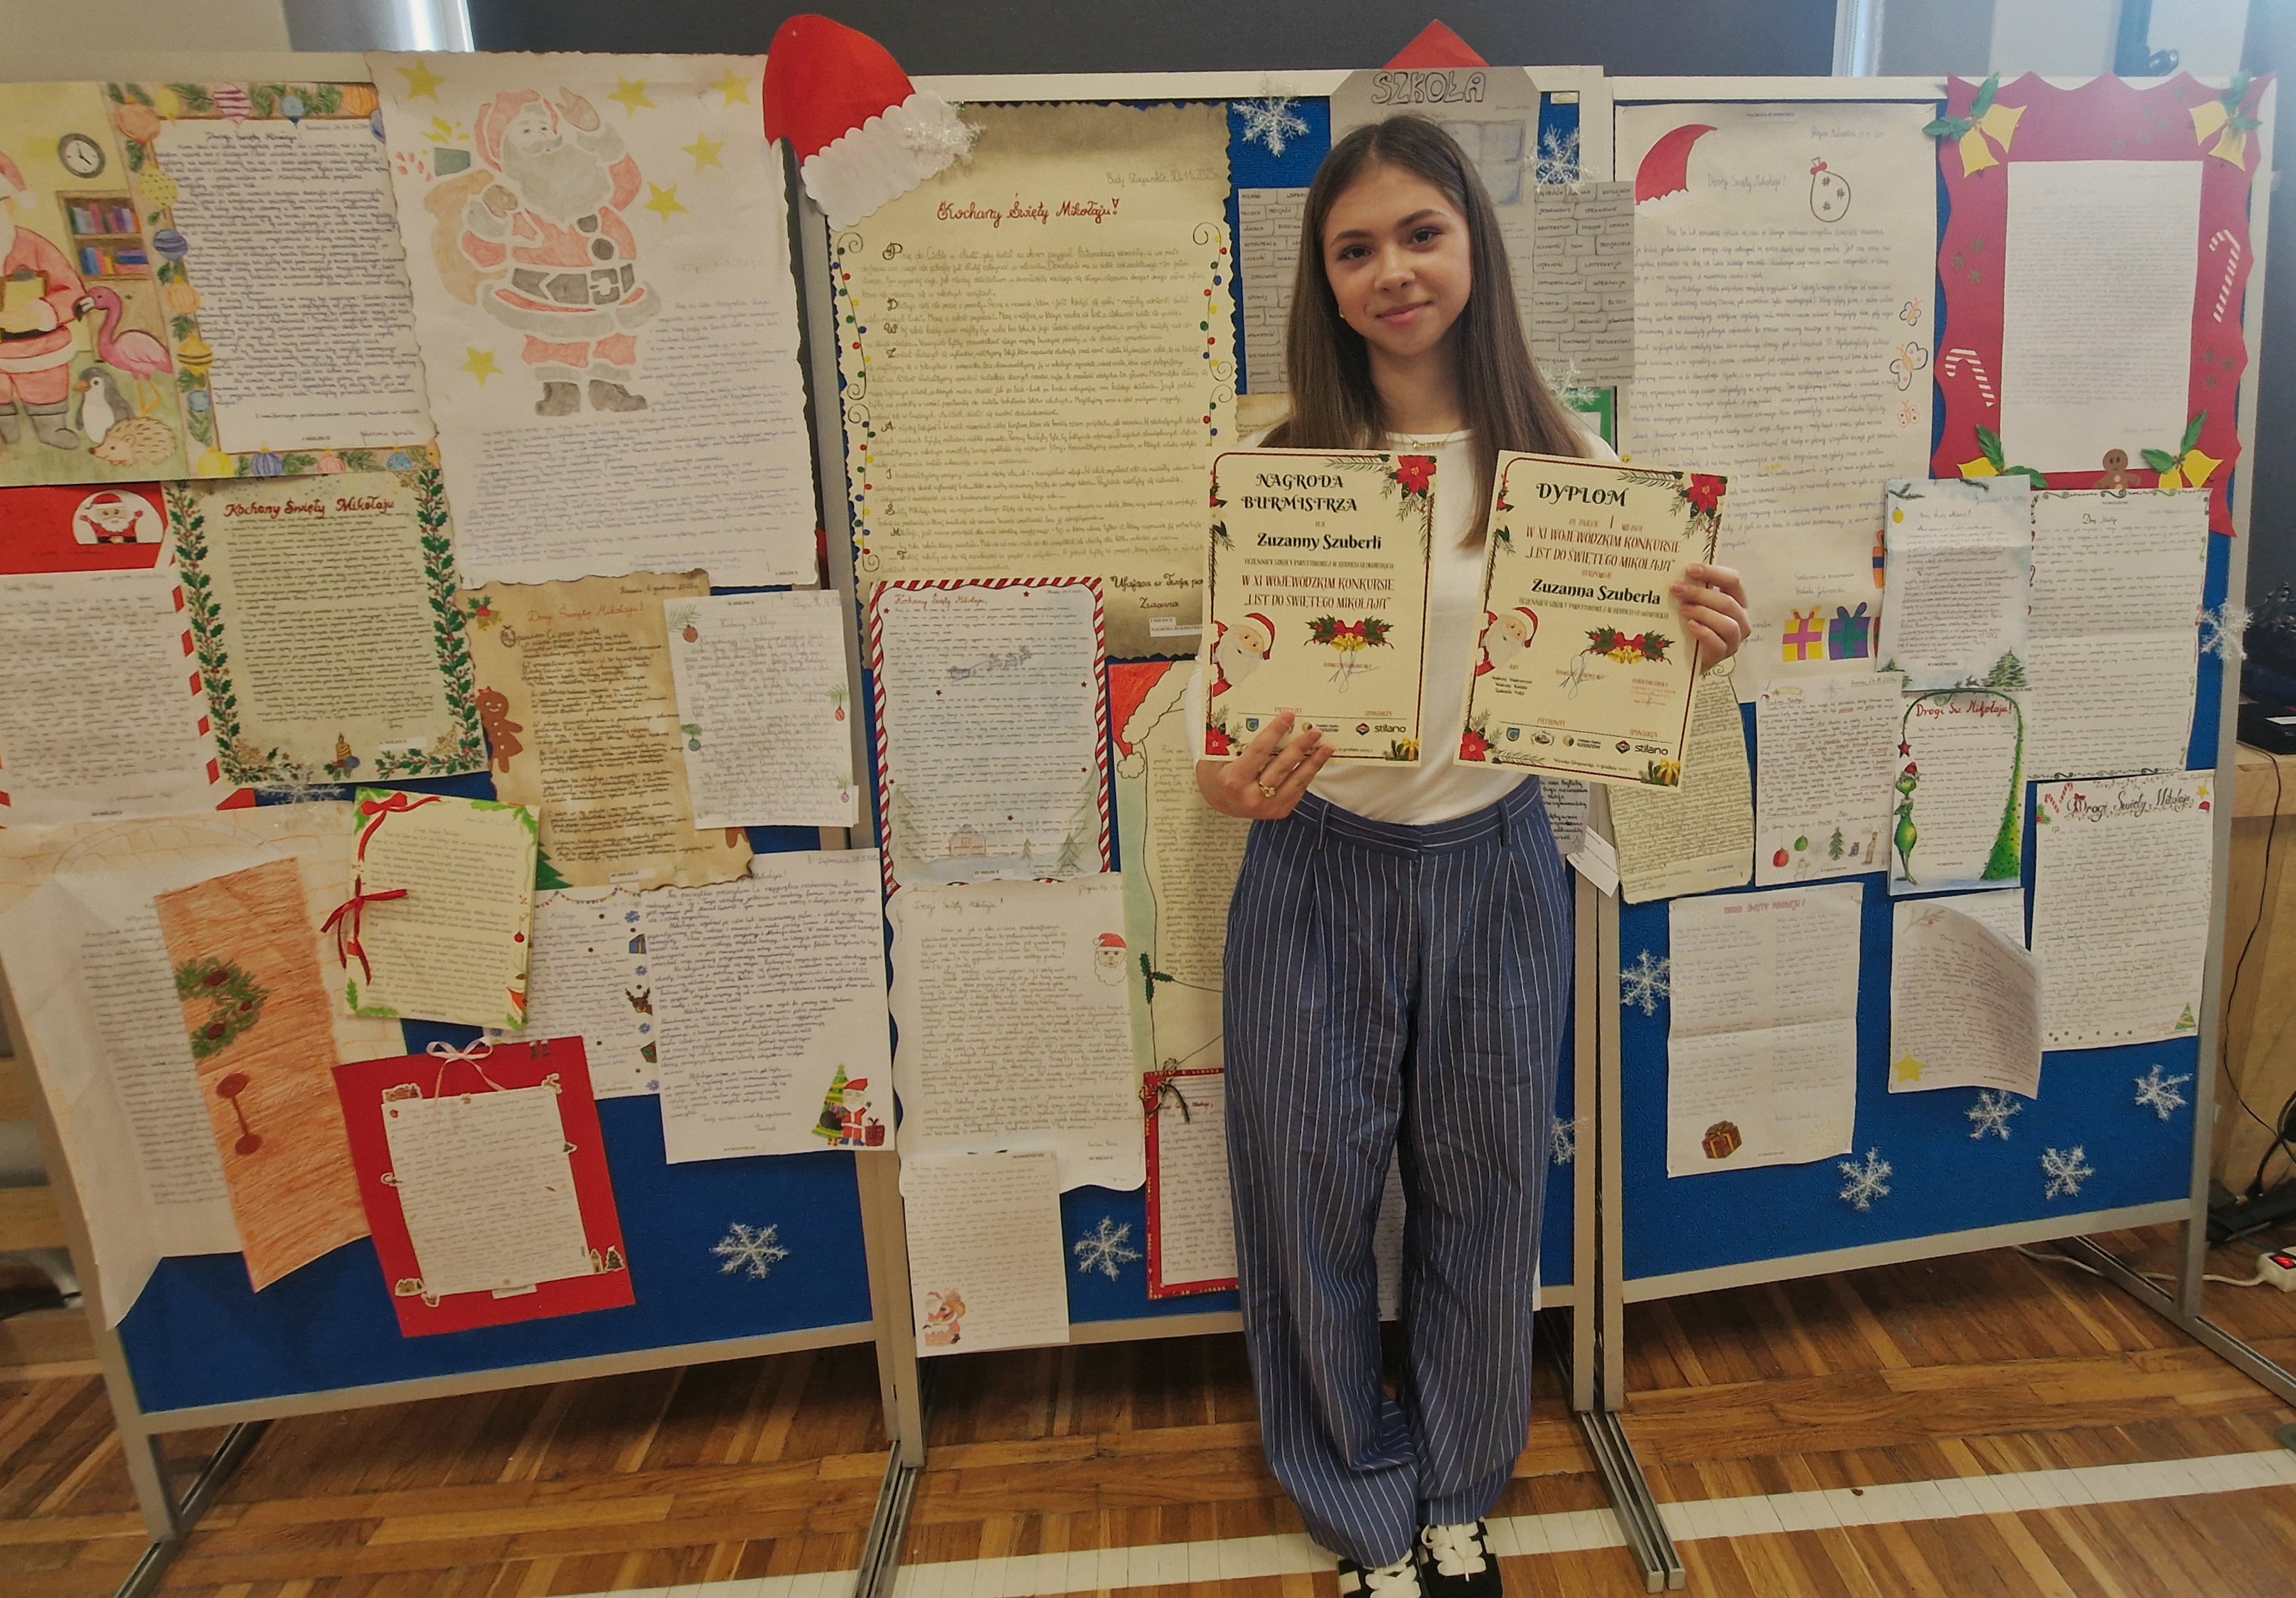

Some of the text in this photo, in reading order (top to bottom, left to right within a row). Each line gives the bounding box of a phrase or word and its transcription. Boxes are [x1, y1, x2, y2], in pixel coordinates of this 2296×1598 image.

[1370, 70, 1486, 105] SZKOŁA
[936, 193, 1121, 228] Kochany Święty Mikołaju!
[1255, 473, 1345, 490] NAGRODA
[1240, 495, 1357, 513] BURMISTRZA
[1536, 483, 1630, 508] DYPLOM
[1256, 532, 1382, 552] Zuzanny Szuberli
[1526, 526, 1681, 553] W XI WOJEWÓDZKIM KONKURSIE
[1553, 547, 1566, 560] DO
[1569, 547, 1618, 567] ŚWIĘTEGO
[1242, 574, 1395, 593] W XI WOJEWÓDZKIM KONKURSIE
[1531, 578, 1661, 605] Zuzanna Szuberla
[1139, 596, 1180, 609] Zuzanna
[1271, 594, 1284, 606] DO
[1286, 593, 1334, 608] ŚWIĘTEGO
[1916, 703, 1948, 720] Drogi
[1374, 724, 1406, 733] stilano
[1635, 745, 1668, 755] stilano
